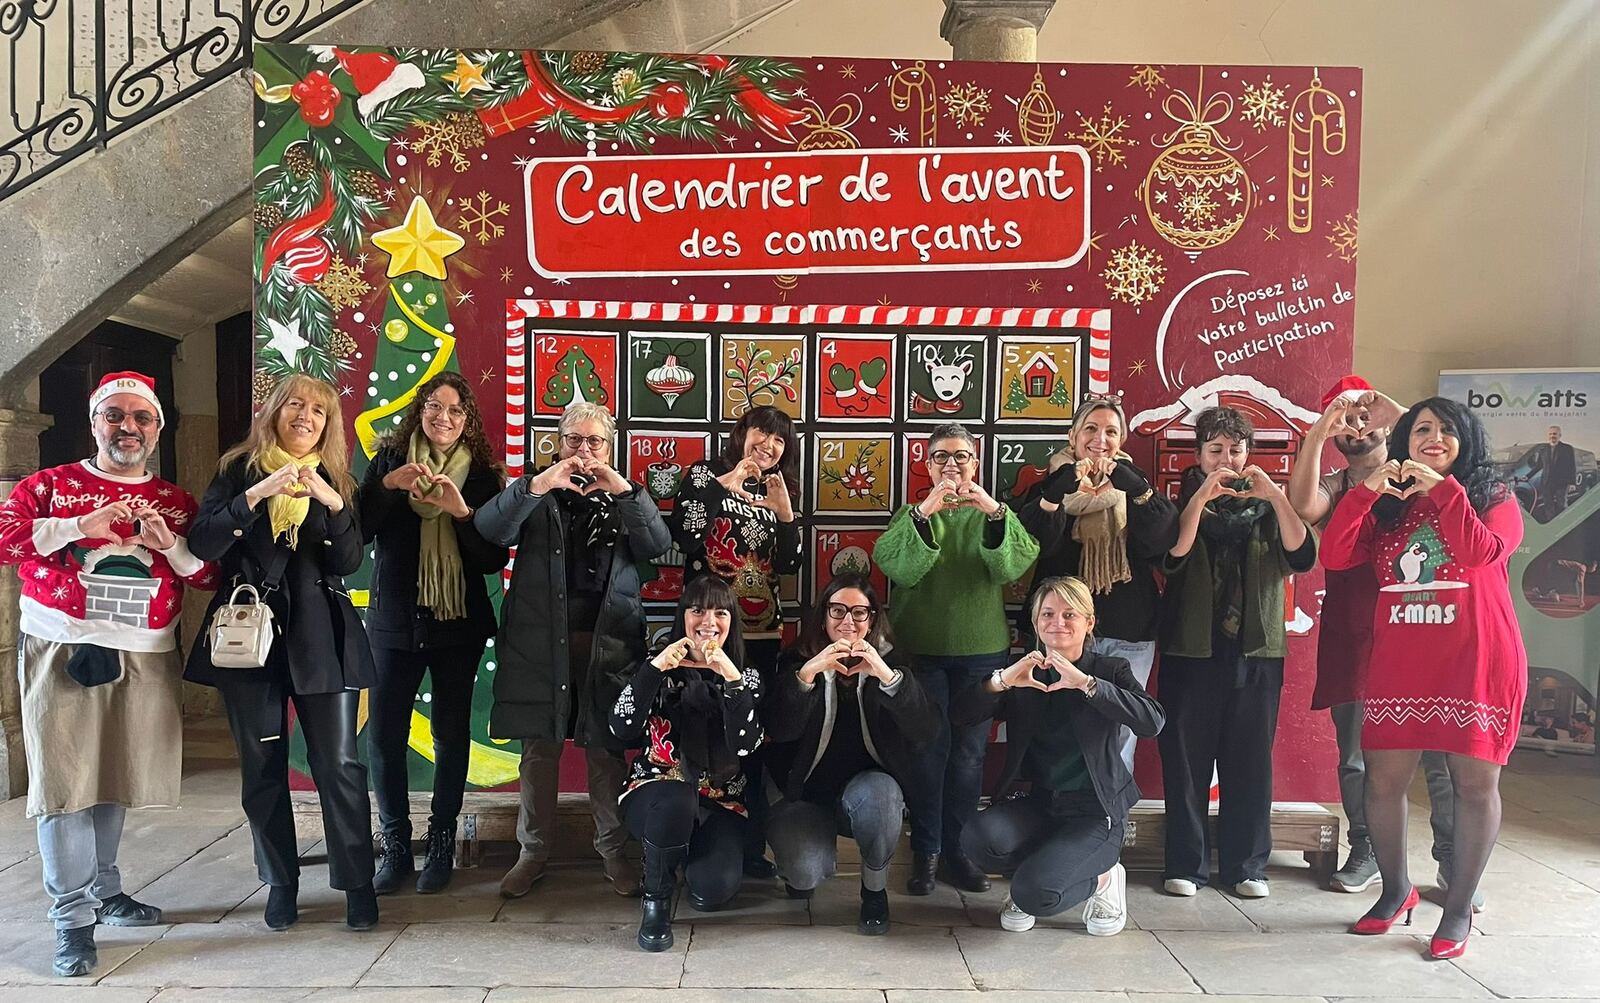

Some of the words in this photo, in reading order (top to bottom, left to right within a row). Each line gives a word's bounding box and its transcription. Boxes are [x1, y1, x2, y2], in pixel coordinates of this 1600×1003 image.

[556, 161, 823, 224] Calendrier
[839, 156, 892, 203] de
[918, 155, 1074, 203] l'avent
[679, 228, 741, 259] des
[764, 218, 1023, 263] commerçants
[1210, 283, 1284, 316] Déposez
[1291, 274, 1309, 291] ici
[1255, 297, 1326, 327] bulletin
[1332, 282, 1354, 305] de
[536, 336, 558, 354] 12
[631, 340, 653, 359] 17
[727, 341, 738, 359] 3
[822, 340, 837, 359] 4
[912, 343, 937, 363] 10
[1005, 345, 1020, 364] 5
[116, 380, 137, 388] HO
[537, 433, 555, 455] 6
[631, 438, 652, 457] 18
[822, 441, 844, 462] 21
[911, 442, 923, 462] 9
[1000, 443, 1026, 464] 22
[50, 489, 110, 512] Happy
[818, 533, 840, 551] 14
[1388, 603, 1457, 625] X-MAS
